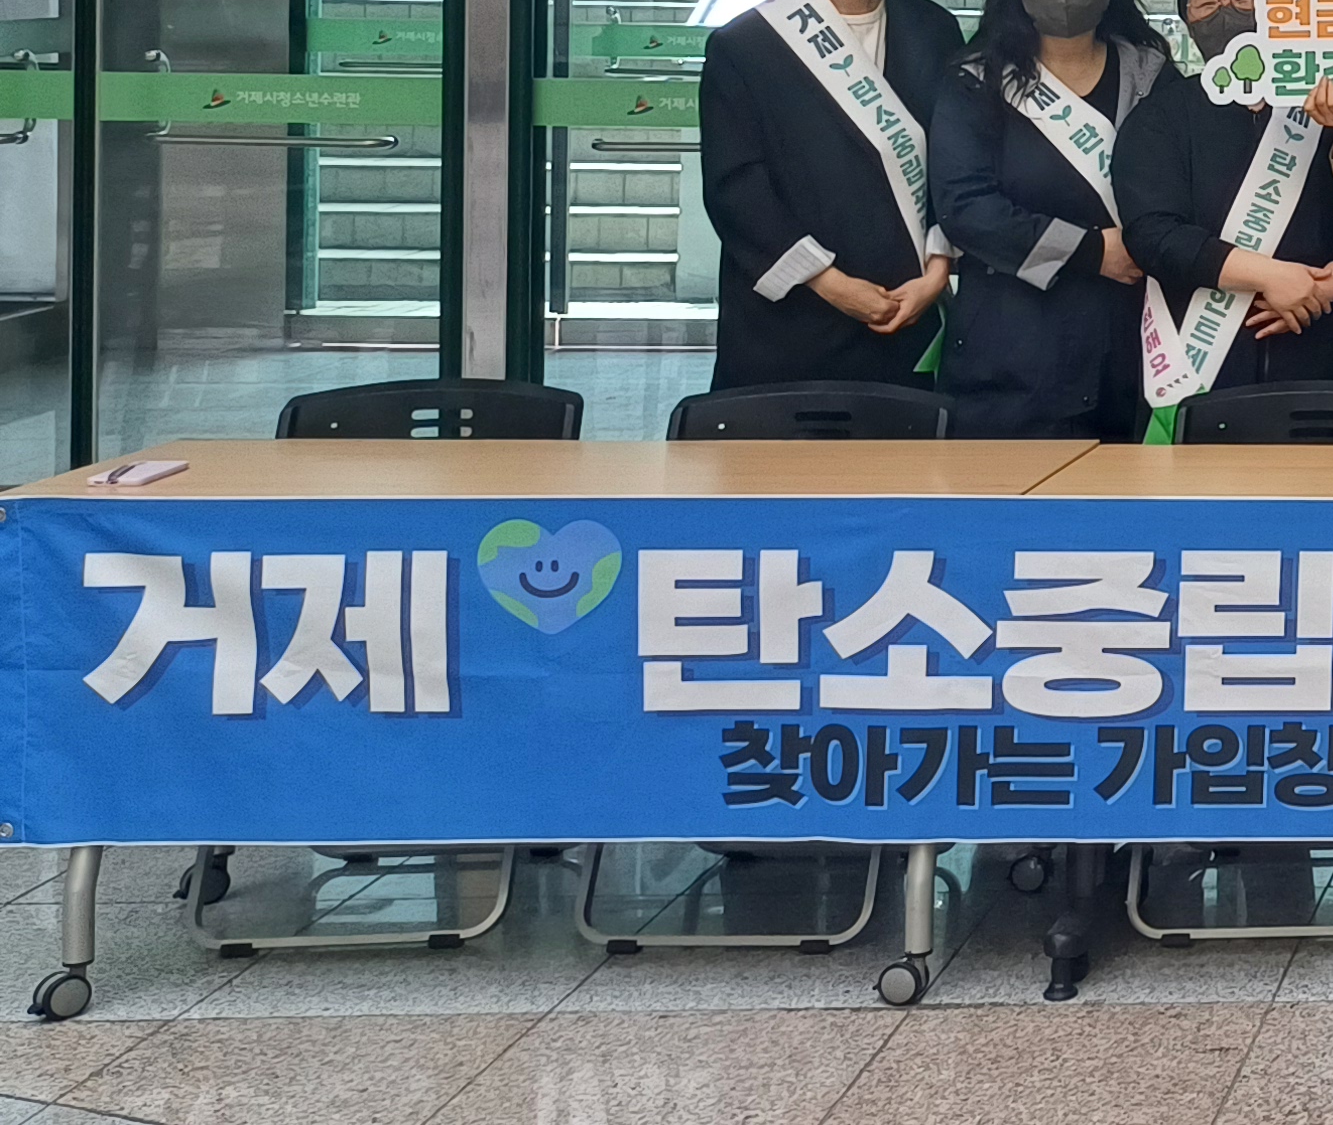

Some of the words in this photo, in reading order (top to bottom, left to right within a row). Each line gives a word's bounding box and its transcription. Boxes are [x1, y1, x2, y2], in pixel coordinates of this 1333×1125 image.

[786, 2, 845, 59] 거제
[236, 90, 361, 108] 거제시청소년수련관
[83, 550, 451, 716] 거제
[719, 721, 1075, 809] 찾아가는
